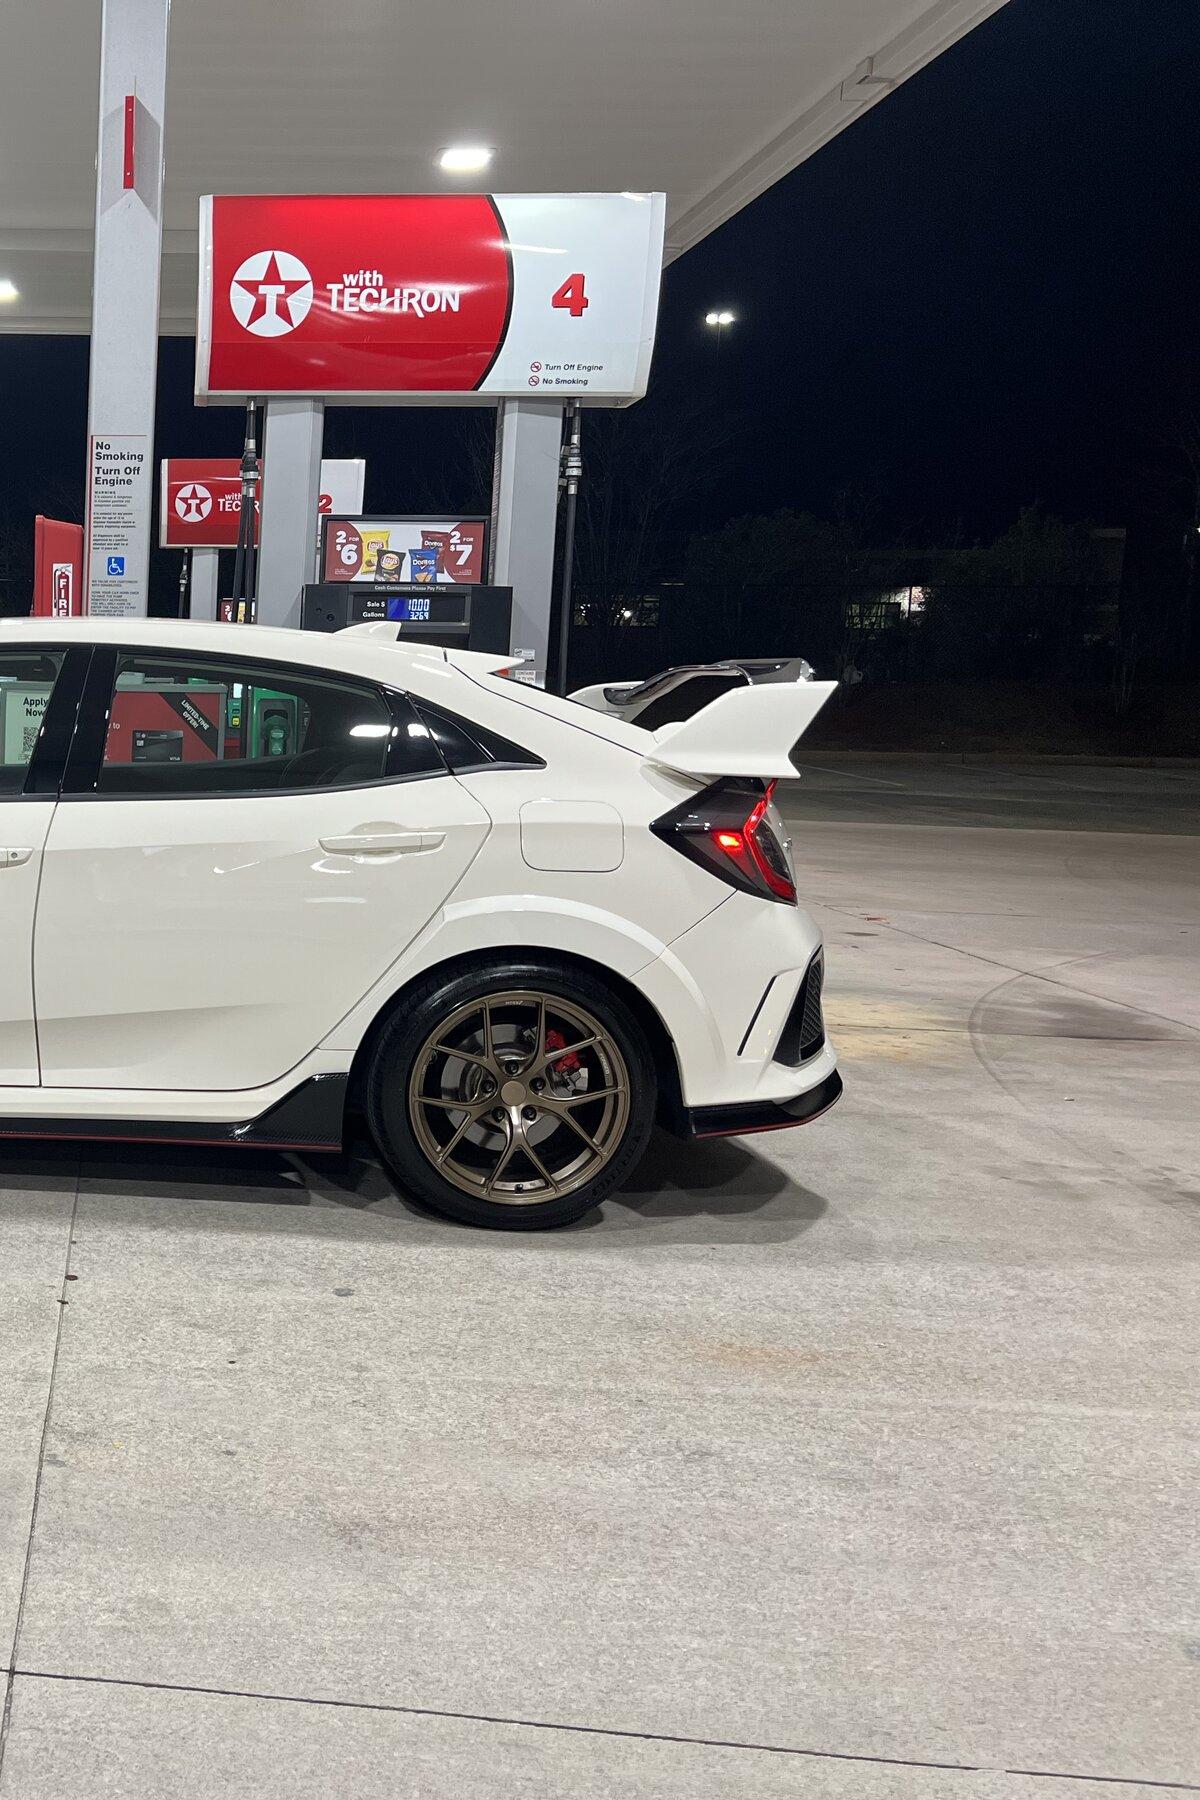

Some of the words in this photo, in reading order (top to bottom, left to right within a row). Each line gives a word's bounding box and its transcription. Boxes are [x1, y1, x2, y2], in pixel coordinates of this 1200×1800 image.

[342, 270, 383, 286] with
[326, 283, 460, 318] TECHRON
[551, 273, 589, 317] 4
[545, 363, 561, 371] Turn
[563, 363, 575, 371] Off
[577, 363, 604, 373] Engine
[555, 378, 588, 387] Smoking
[95, 441, 111, 450] No
[95, 451, 144, 463] Smoking
[94, 466, 120, 475] Turn
[124, 466, 141, 475] Off
[94, 476, 133, 487] Engine
[225, 492, 242, 501] with
[318, 494, 333, 514] 2
[335, 530, 347, 543] 2
[449, 530, 461, 544] 2
[424, 540, 443, 548] Doritos
[335, 543, 358, 565] $6
[449, 544, 473, 566] $7
[412, 559, 435, 567] Doritos
[22, 697, 48, 707] Apply
[112, 722, 121, 730] to
